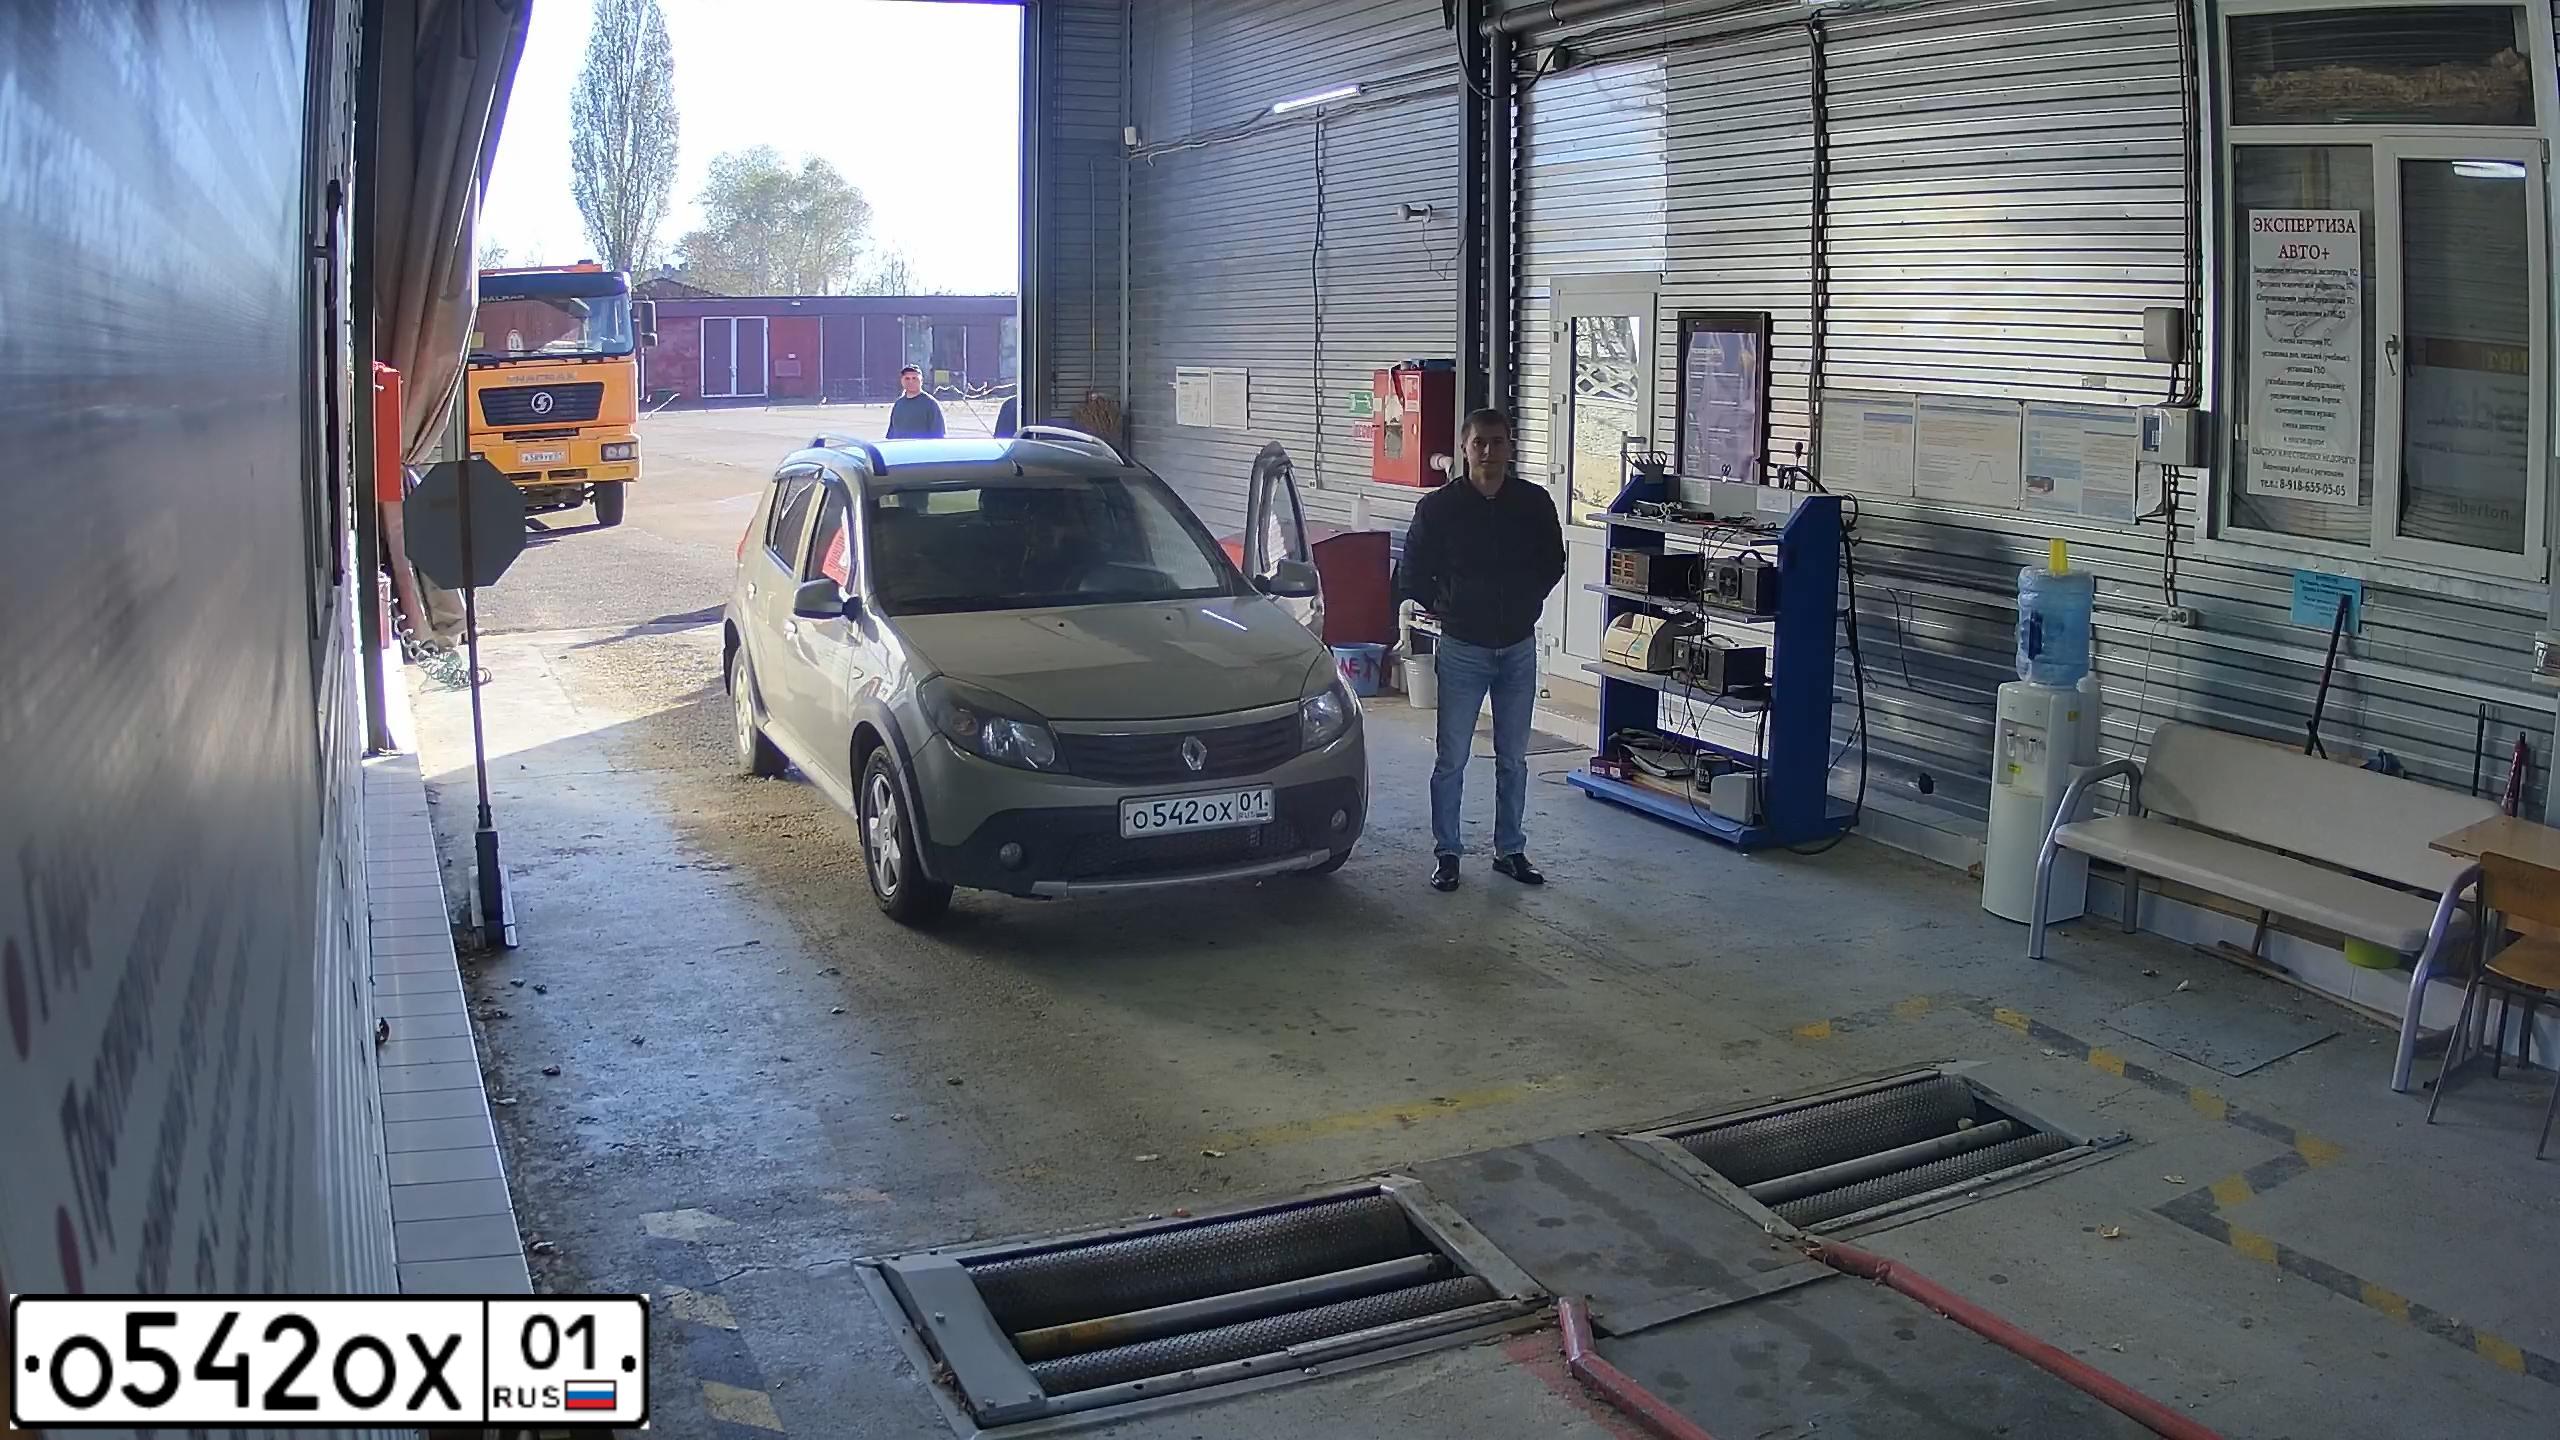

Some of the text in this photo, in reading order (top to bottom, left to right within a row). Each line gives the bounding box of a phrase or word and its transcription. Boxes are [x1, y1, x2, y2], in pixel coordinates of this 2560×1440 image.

[2253, 217, 2356, 233] ЭКСПЕРТИЗА
[2278, 244, 2330, 260] АВТО+
[1239, 791, 1263, 811] 01
